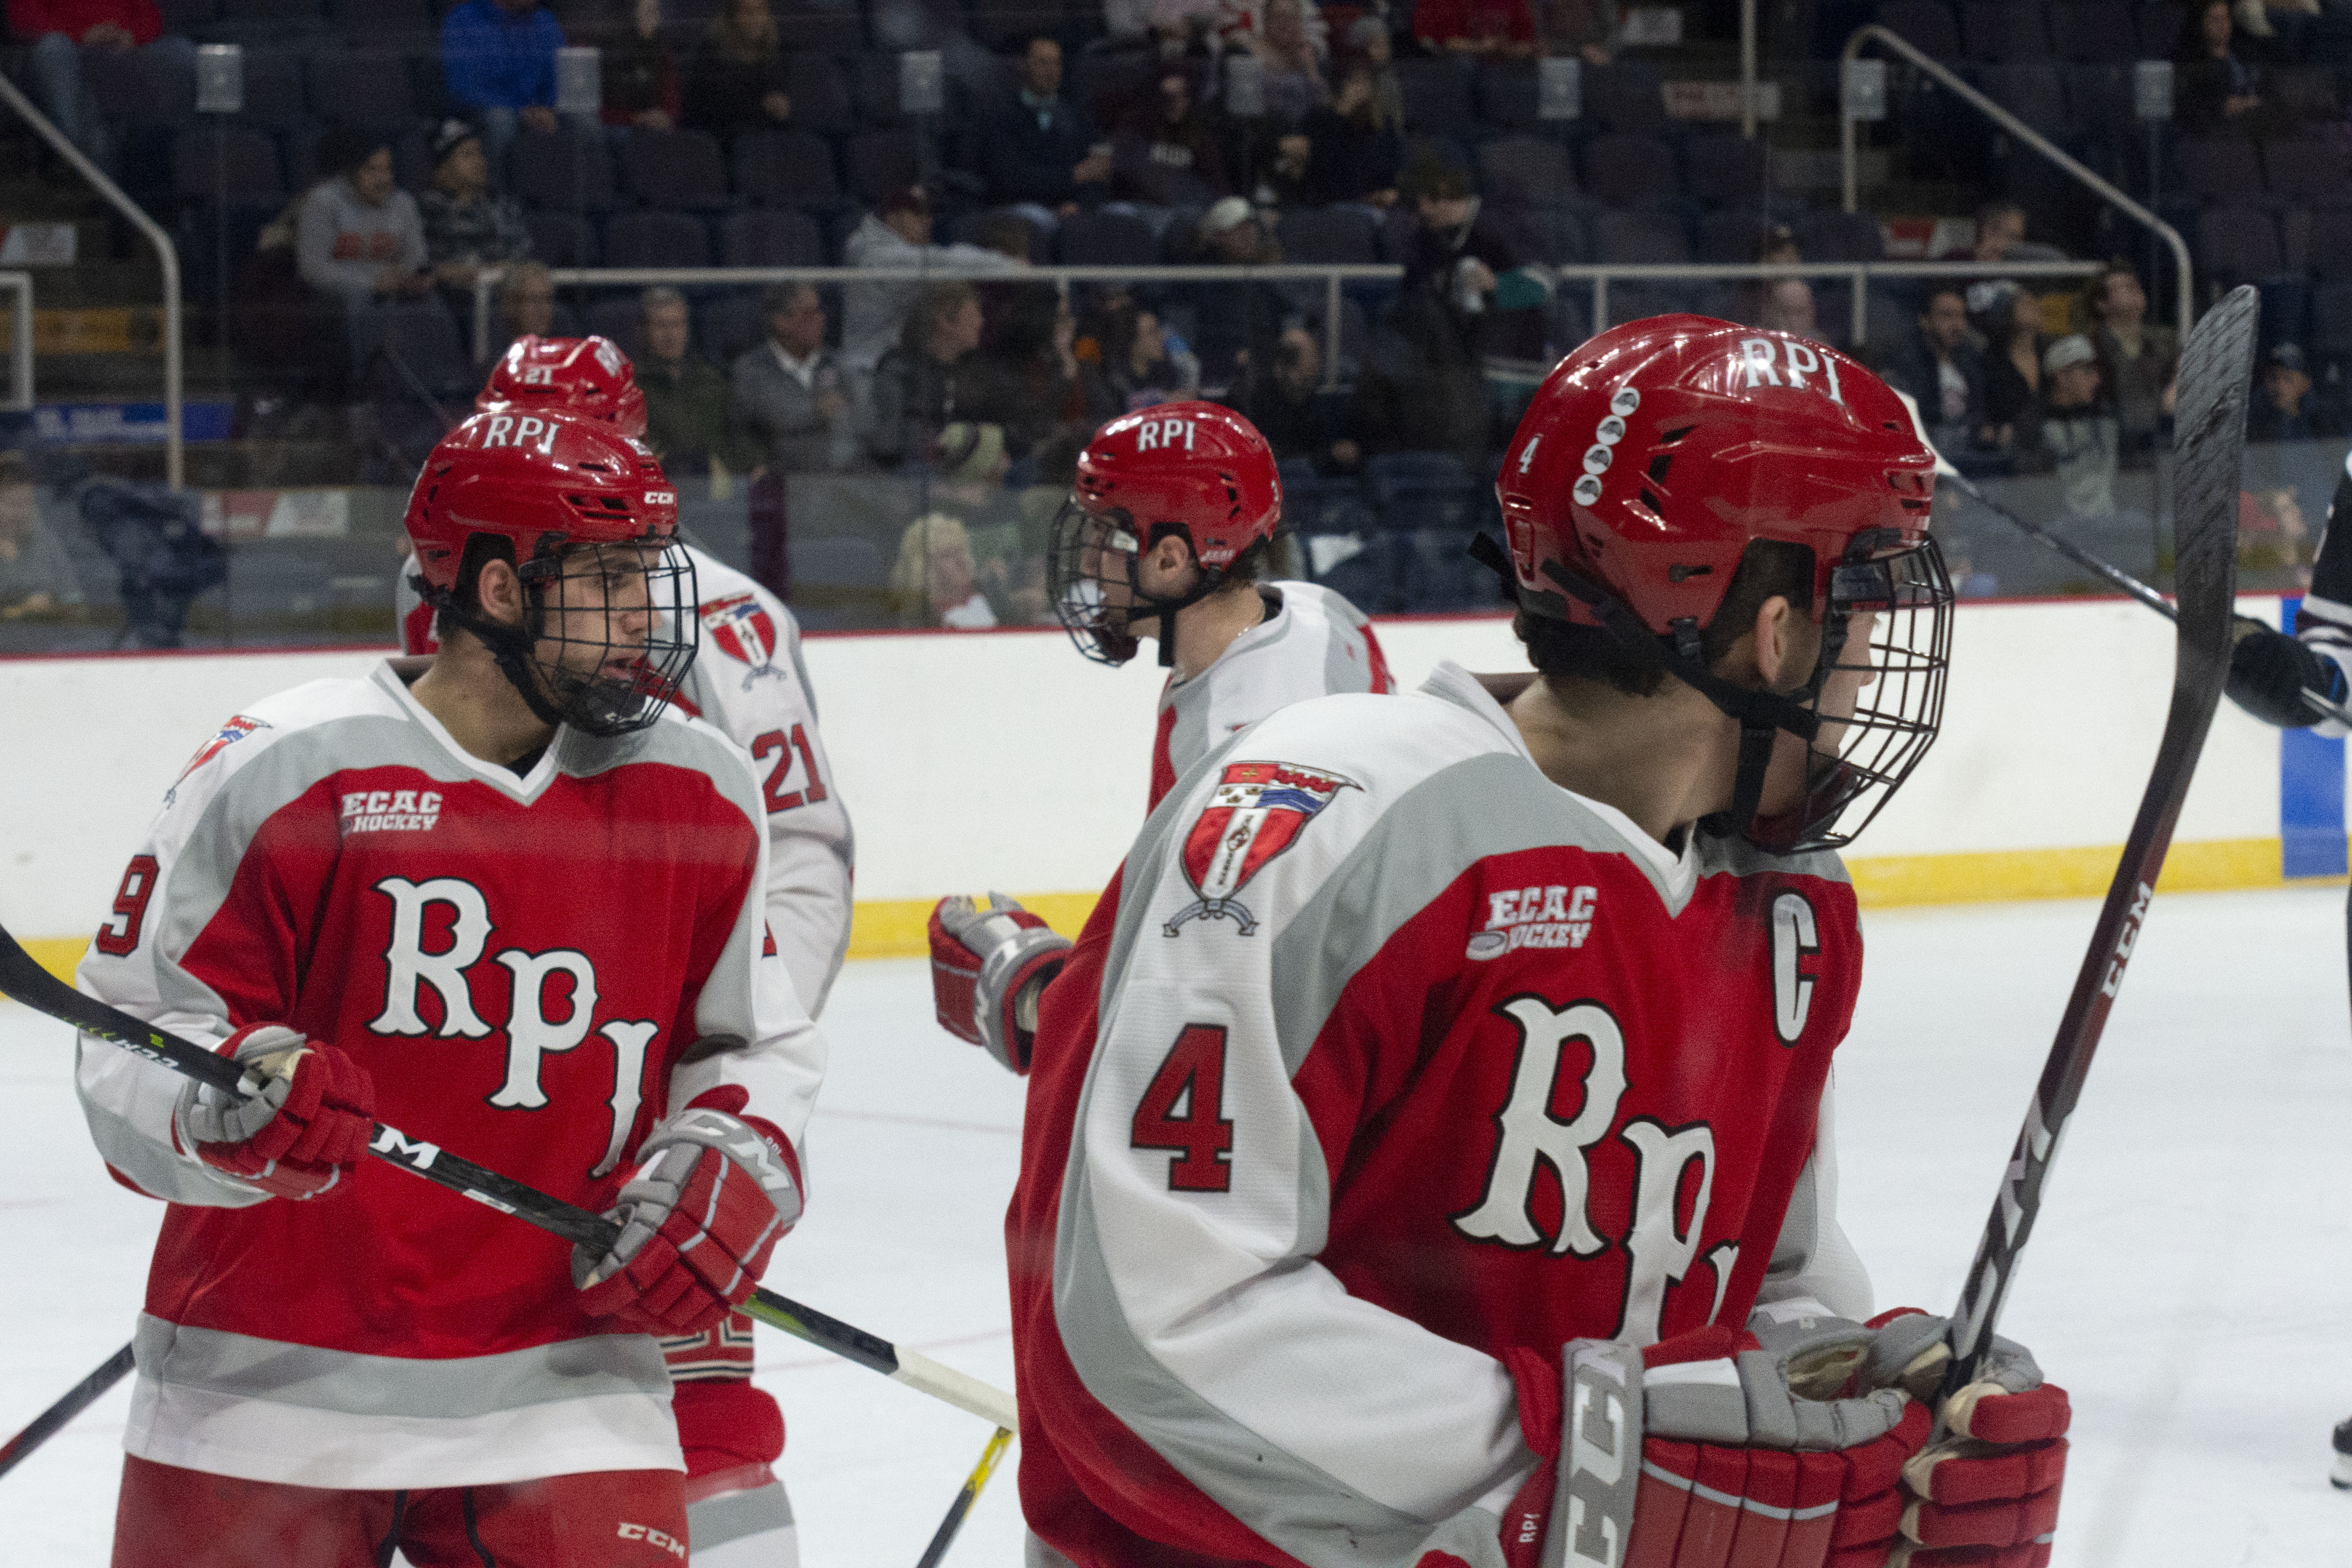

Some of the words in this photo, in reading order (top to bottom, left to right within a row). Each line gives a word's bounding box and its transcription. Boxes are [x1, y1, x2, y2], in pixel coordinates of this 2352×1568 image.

[524, 367, 553, 386] 21
[1740, 338, 1845, 406] RPI
[482, 416, 561, 456] RPI
[1137, 418, 1196, 453] RPI
[1519, 436, 1540, 474] 4
[751, 722, 828, 815] 21
[341, 789, 443, 818] ECAC
[352, 813, 440, 833] HOCKEY
[95, 854, 160, 958] 9
[1484, 885, 1598, 931] ECAC
[2103, 882, 2153, 998] CCM
[1770, 888, 1820, 1048] C
[364, 875, 659, 1179] RPI
[1129, 1022, 1234, 1192] 4
[617, 1521, 685, 1559] CCM
[1519, 1513, 1541, 1543] RPI
